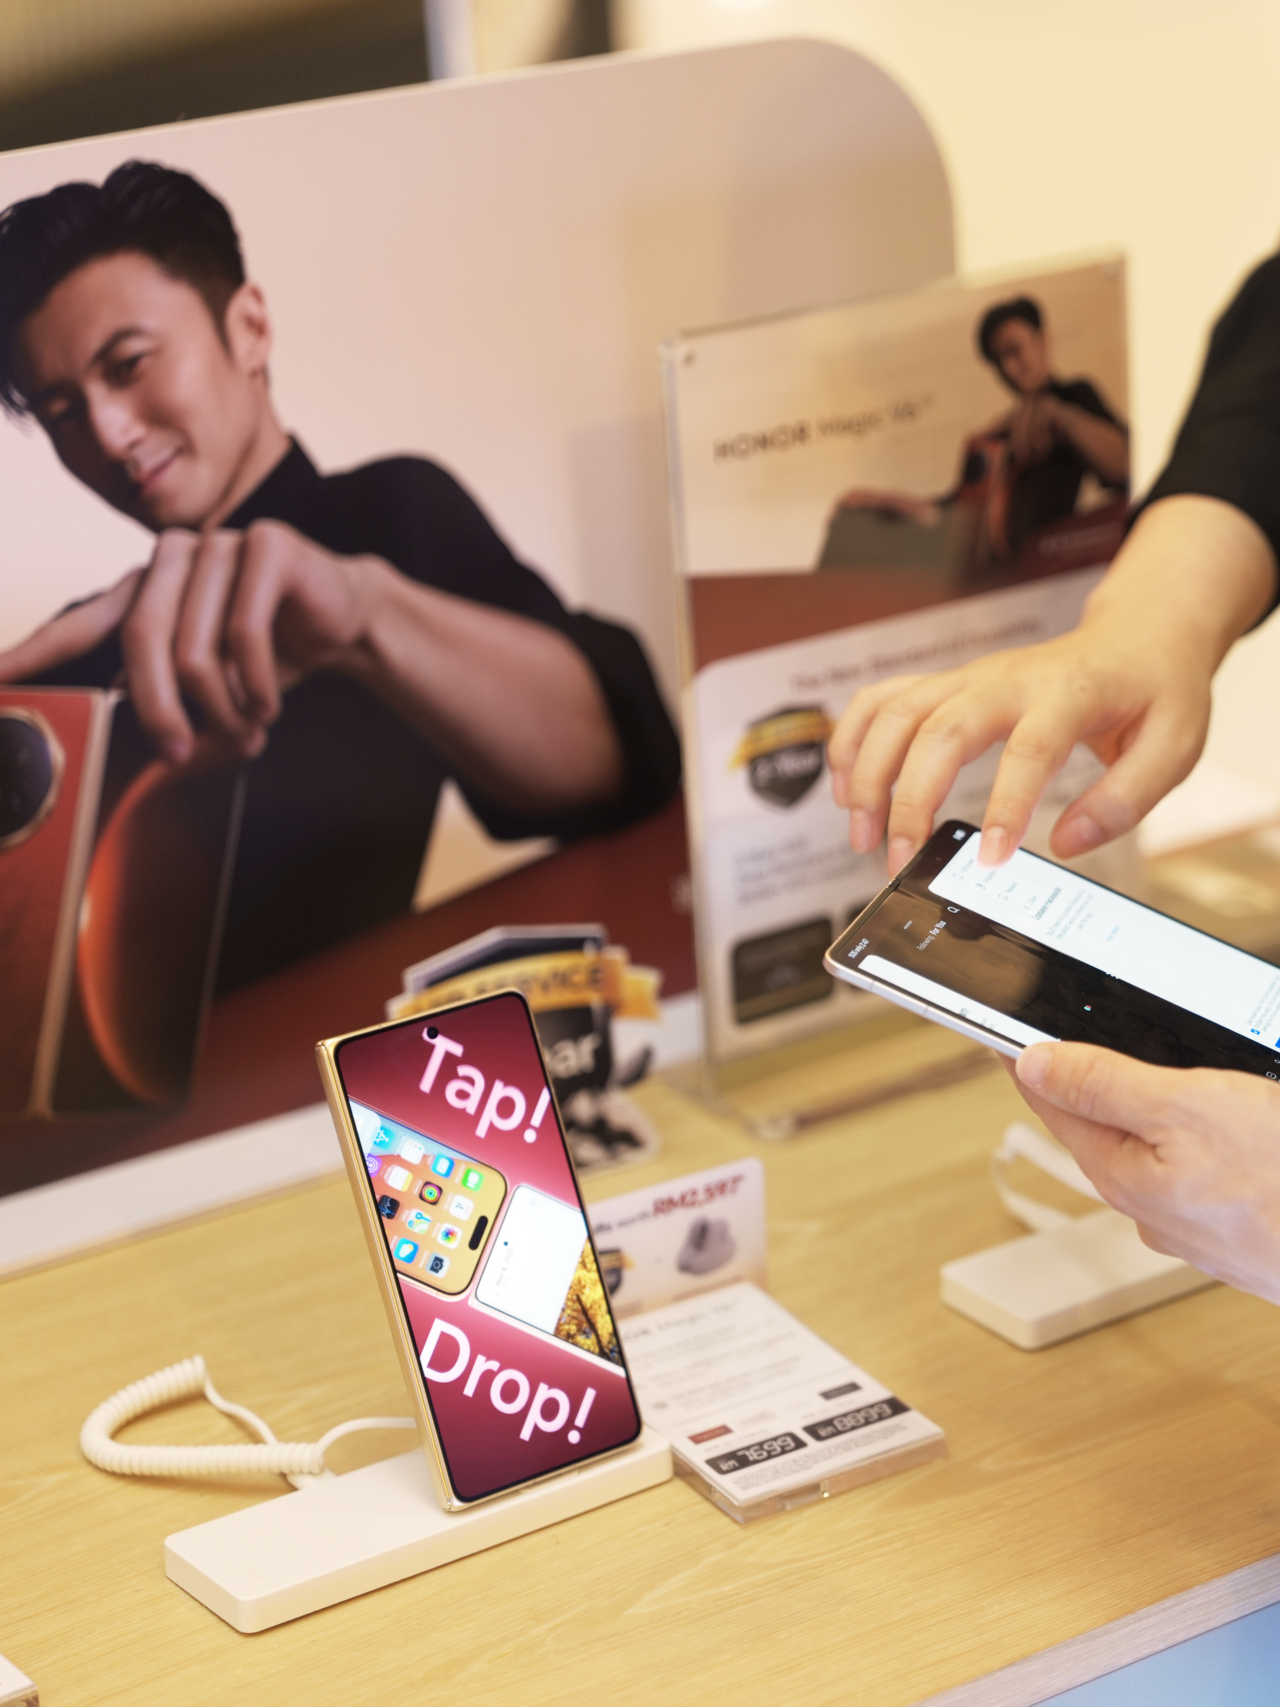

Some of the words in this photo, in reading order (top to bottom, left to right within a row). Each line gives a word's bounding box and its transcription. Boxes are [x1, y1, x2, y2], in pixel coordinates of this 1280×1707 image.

[712, 419, 812, 465] HONOR
[917, 935, 935, 951] Following
[929, 928, 940, 936] For
[935, 920, 947, 929] You
[419, 1027, 551, 1144] Tap!
[419, 1317, 598, 1445] Drop!
[833, 1402, 893, 1432] 8899
[719, 1459, 740, 1472] RM
[736, 1435, 796, 1462] 7699
